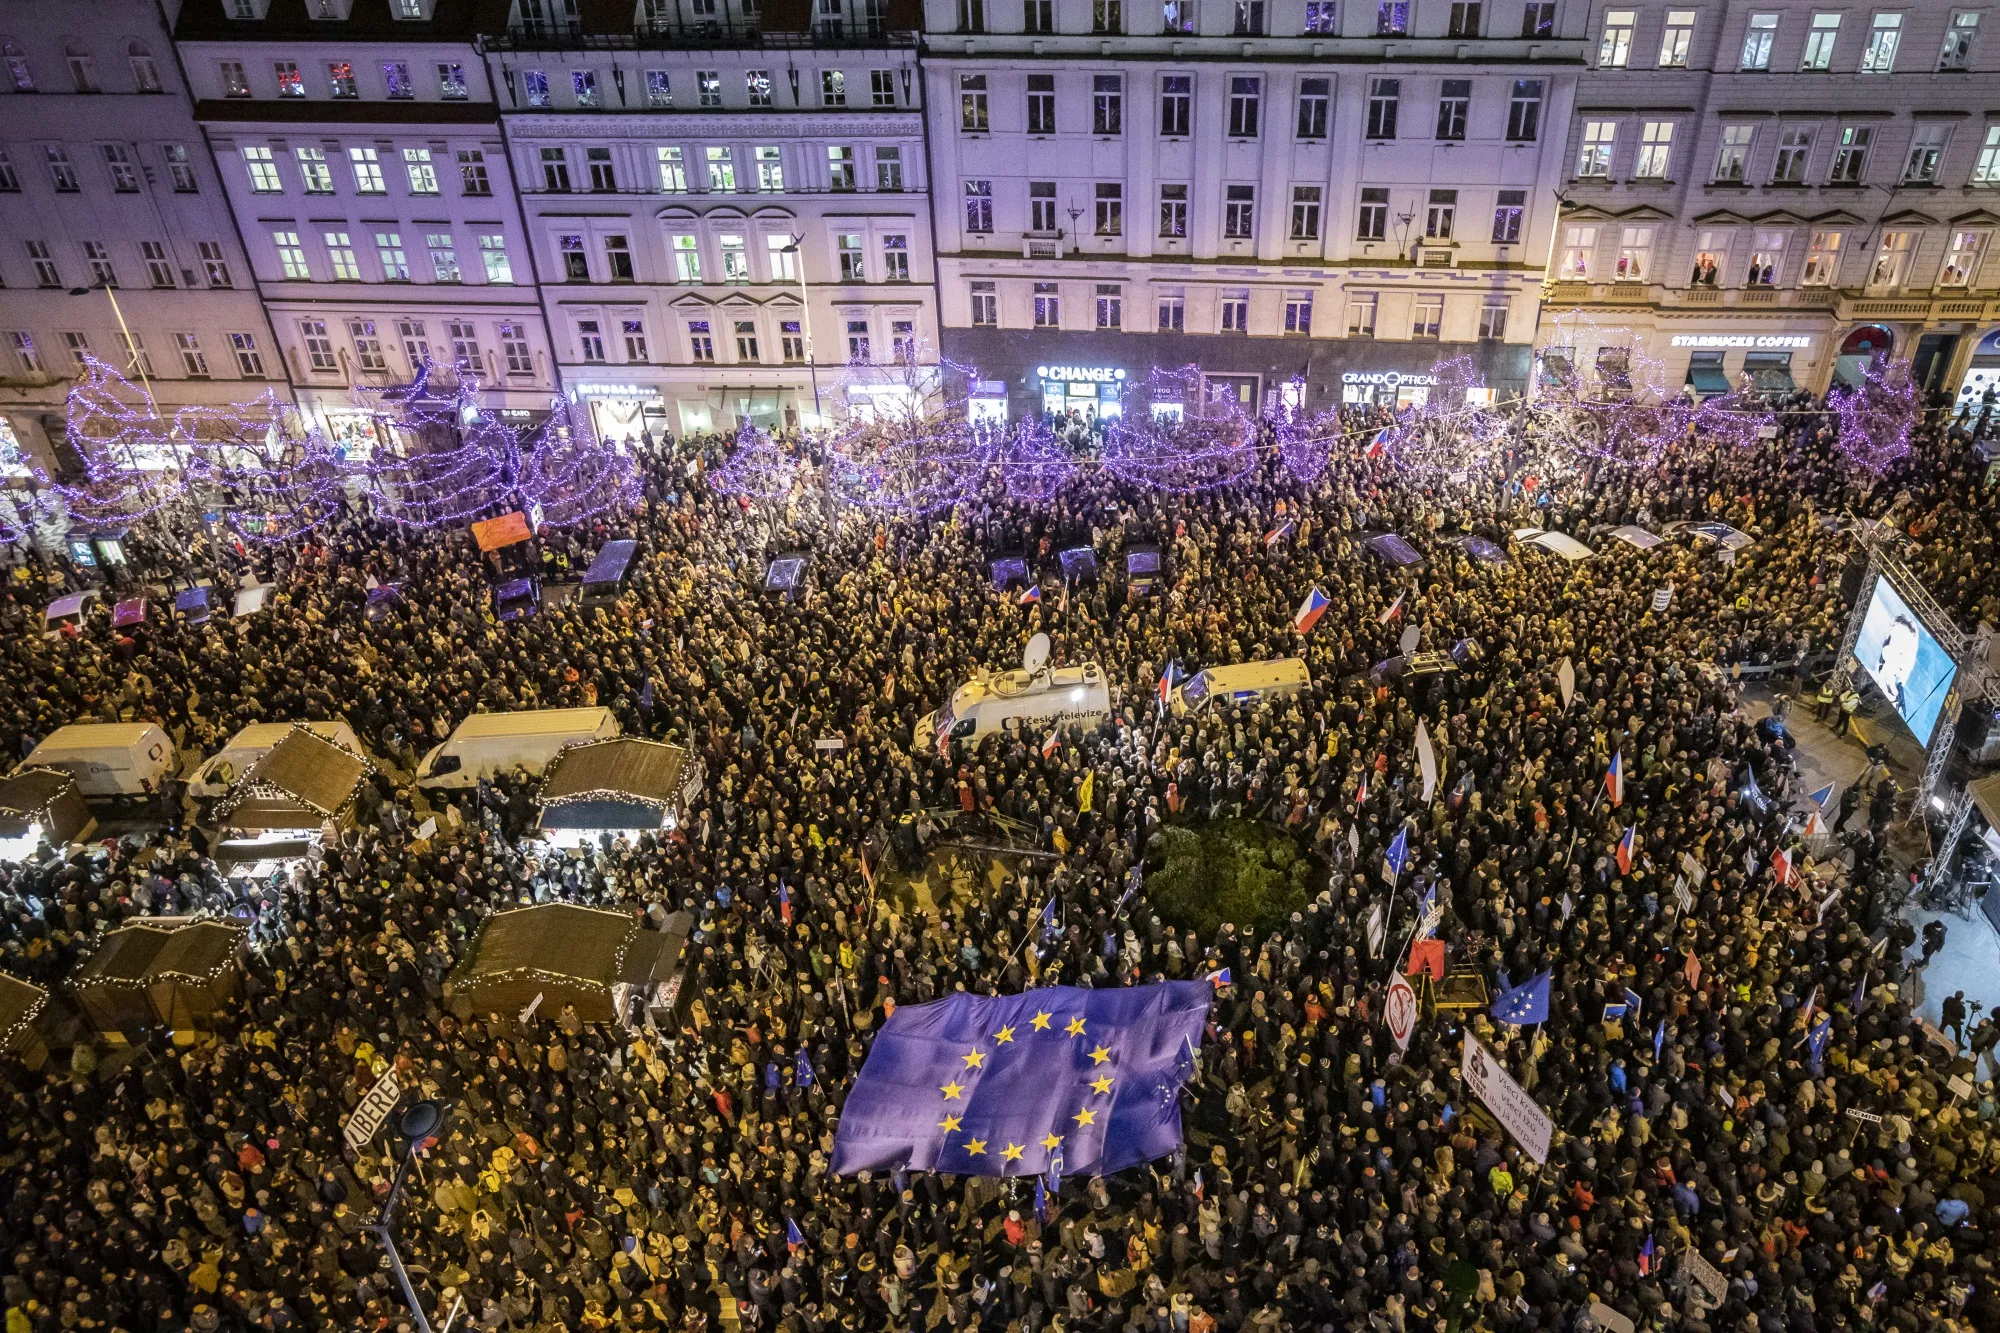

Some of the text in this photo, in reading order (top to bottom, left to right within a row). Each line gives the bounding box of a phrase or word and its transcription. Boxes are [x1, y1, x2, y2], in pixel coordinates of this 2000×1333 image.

[1671, 336, 1811, 347] STARBUCKS COFFEE
[1049, 366, 1115, 382] CHANGE
[1027, 714, 1057, 725] česk
